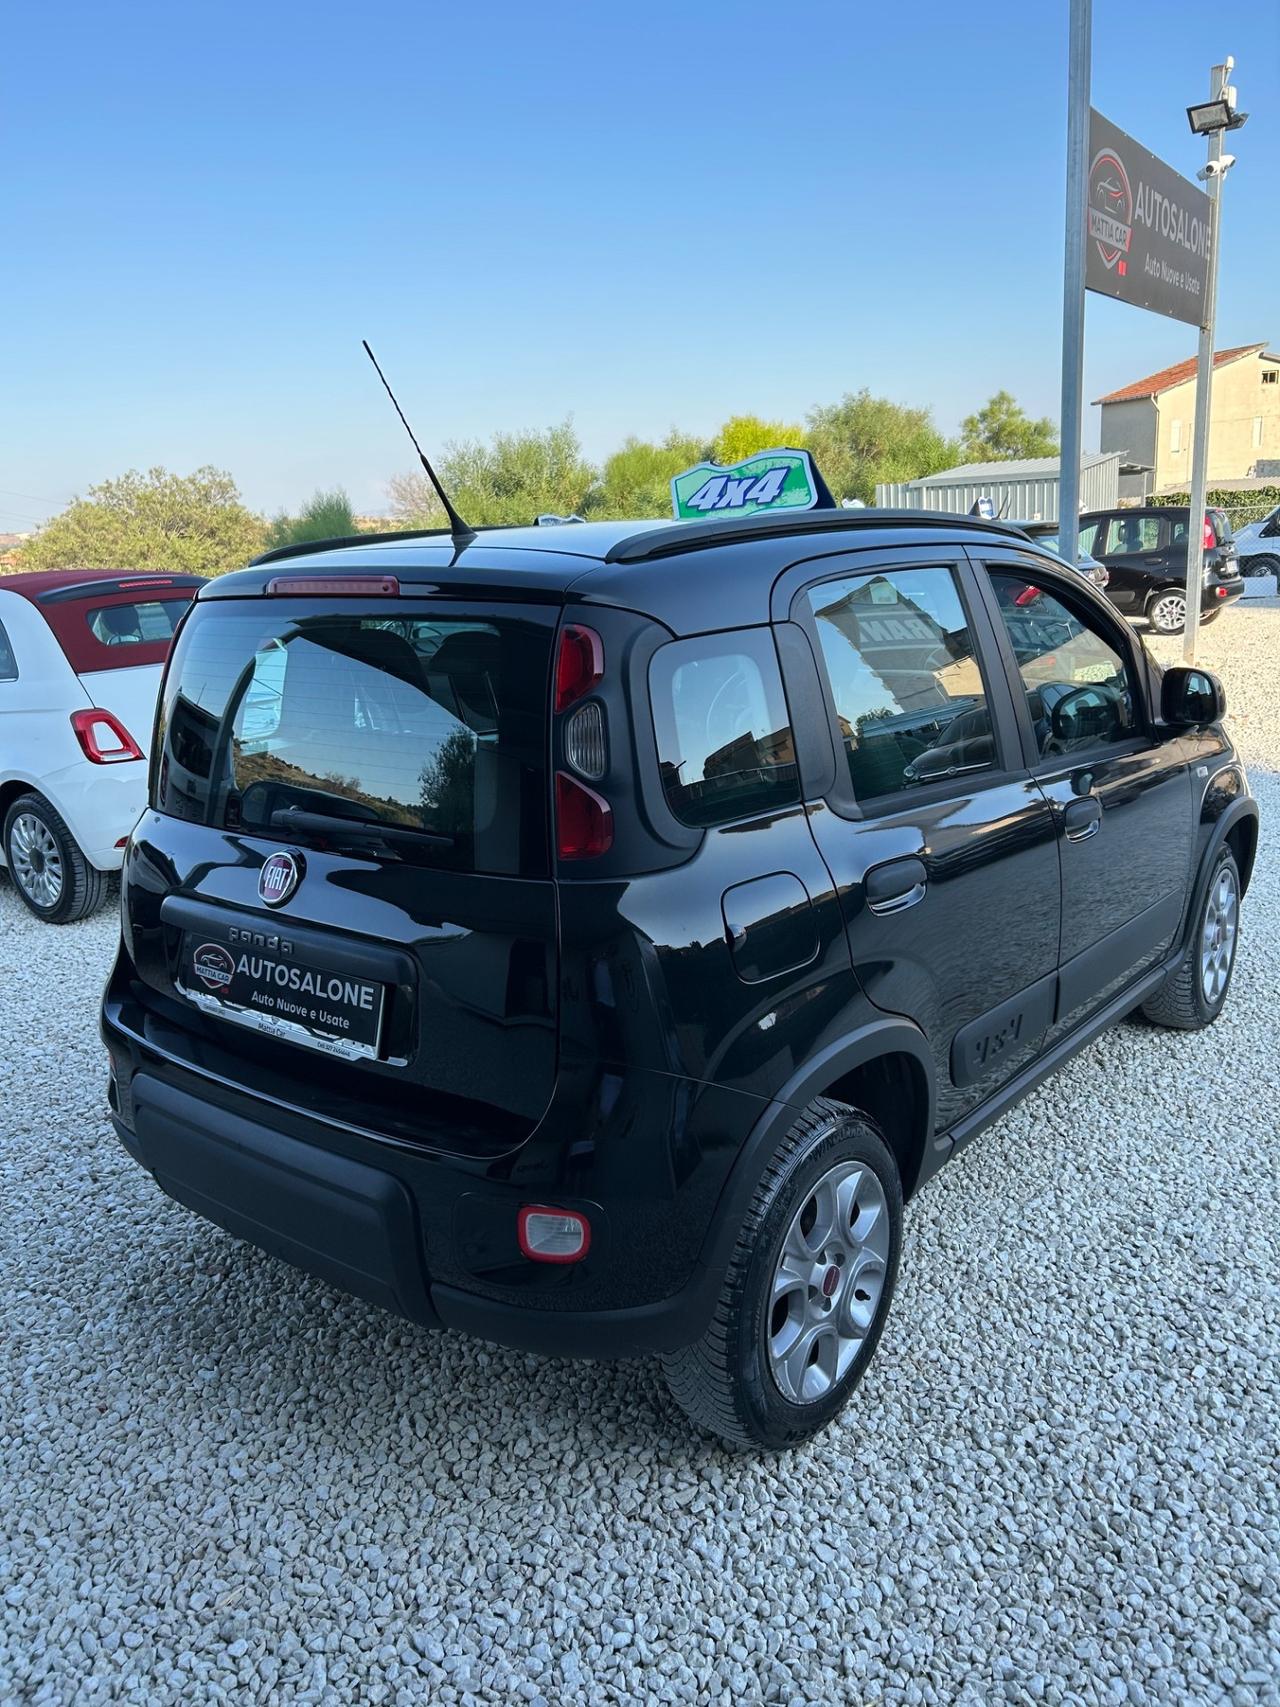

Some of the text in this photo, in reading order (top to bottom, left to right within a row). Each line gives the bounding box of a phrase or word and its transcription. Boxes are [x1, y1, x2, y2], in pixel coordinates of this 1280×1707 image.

[1114, 224, 1127, 245] CAR
[1135, 181, 1211, 260] AUTOSALONE
[1144, 252, 1160, 278] Auto
[1161, 259, 1179, 287] Nuove
[1185, 271, 1200, 295] Usate
[265, 866, 290, 890] FIAT
[196, 965, 230, 983] MATTIA CAR
[237, 954, 376, 1011] AUTOSALONE
[252, 990, 350, 1029] Auto Nuove e Usate
[258, 1022, 287, 1037] Mattia Car
